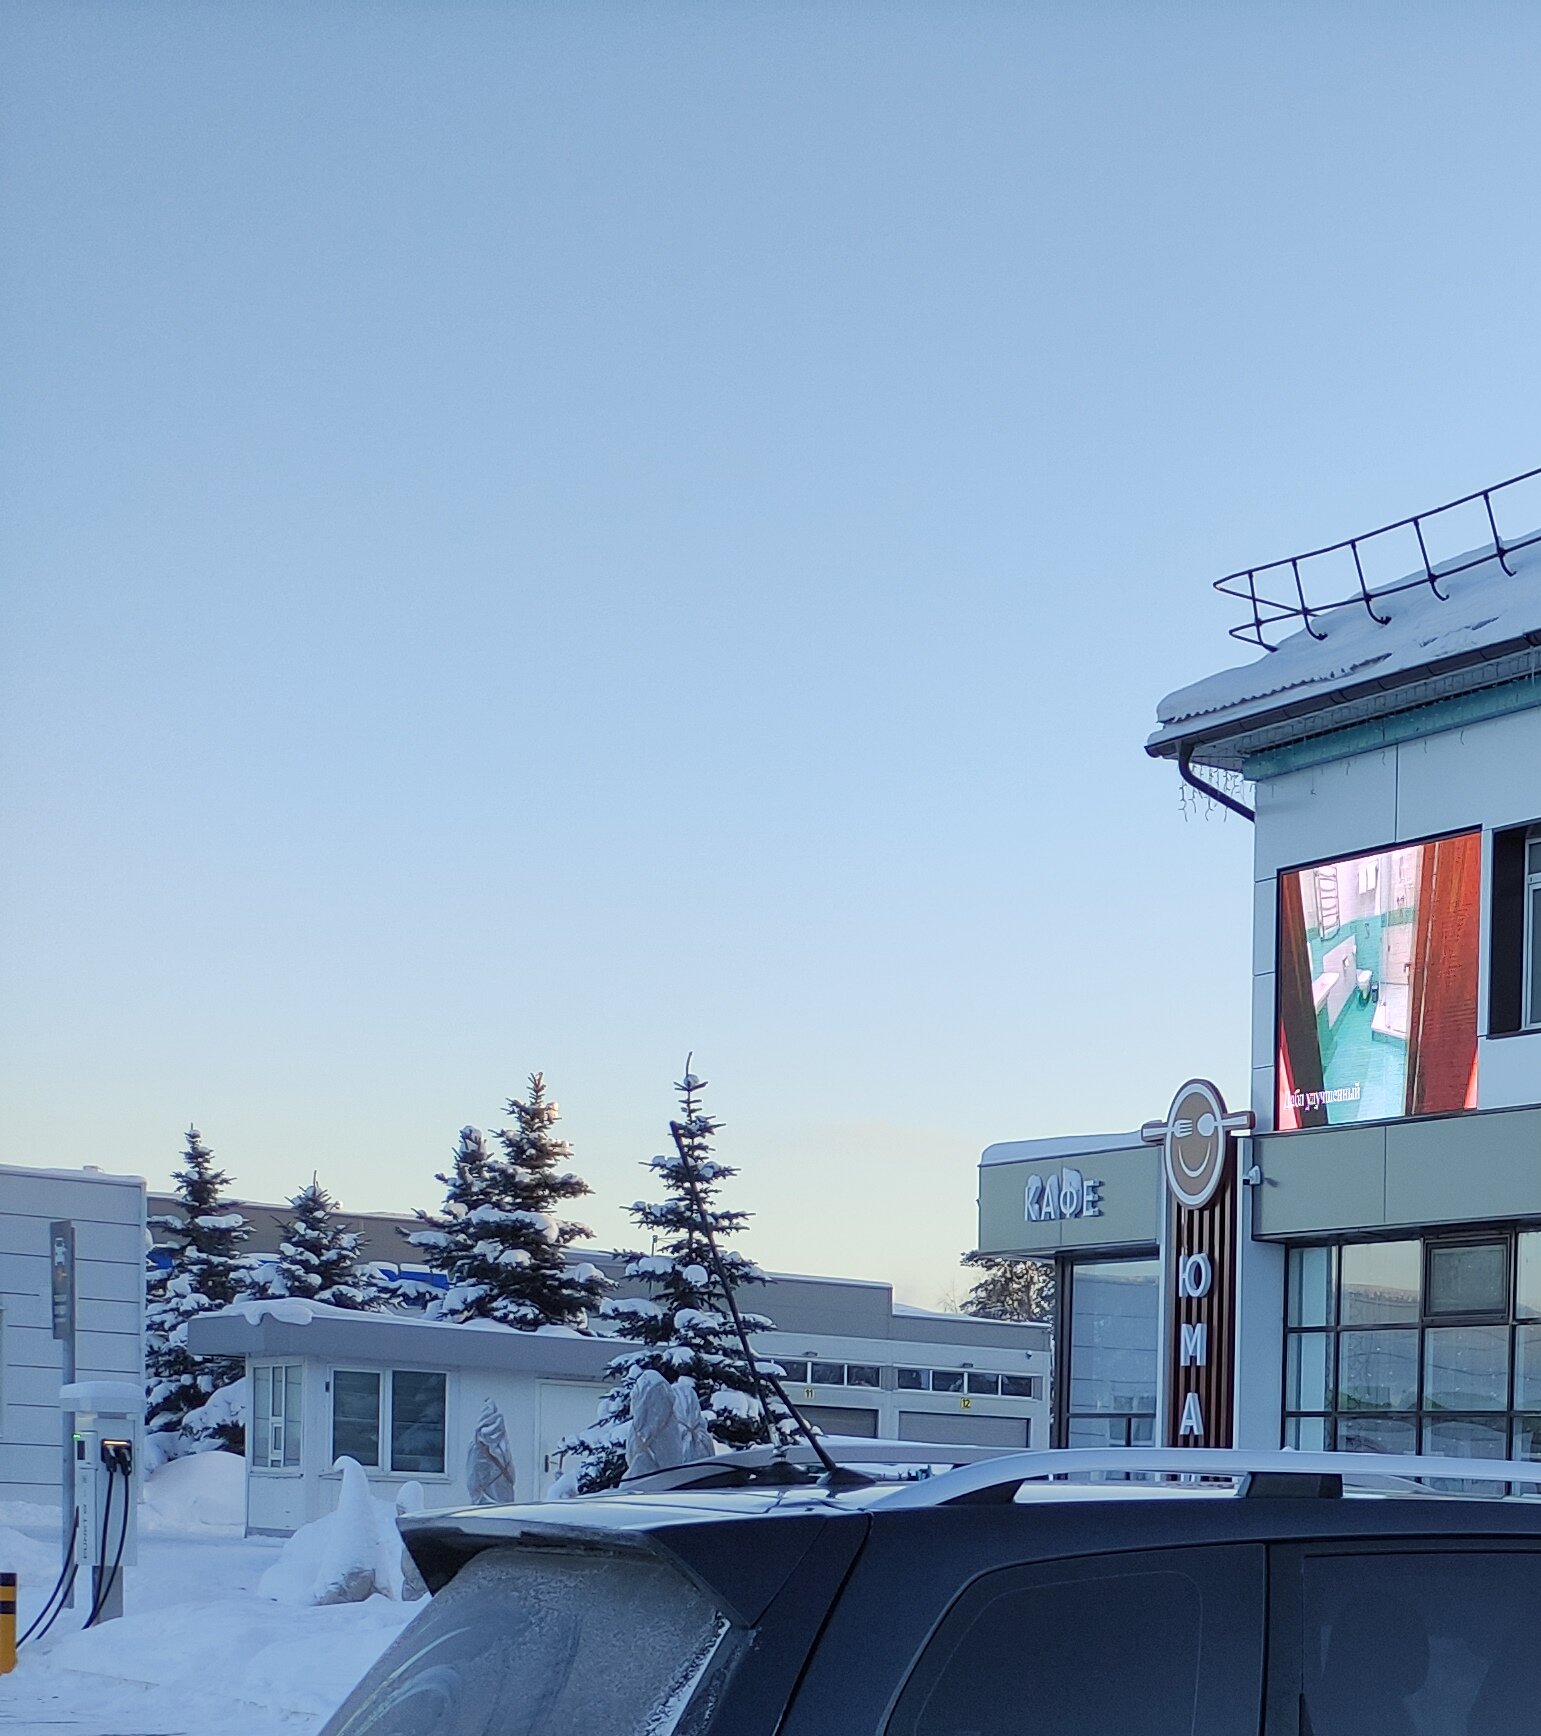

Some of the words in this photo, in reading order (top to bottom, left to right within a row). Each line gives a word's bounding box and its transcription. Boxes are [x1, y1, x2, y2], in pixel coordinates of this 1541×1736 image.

[1023, 1174, 1101, 1222] КАФЕ
[1178, 1252, 1212, 1436] ЮМА
[805, 1389, 814, 1398] 11
[960, 1398, 970, 1408] 12
